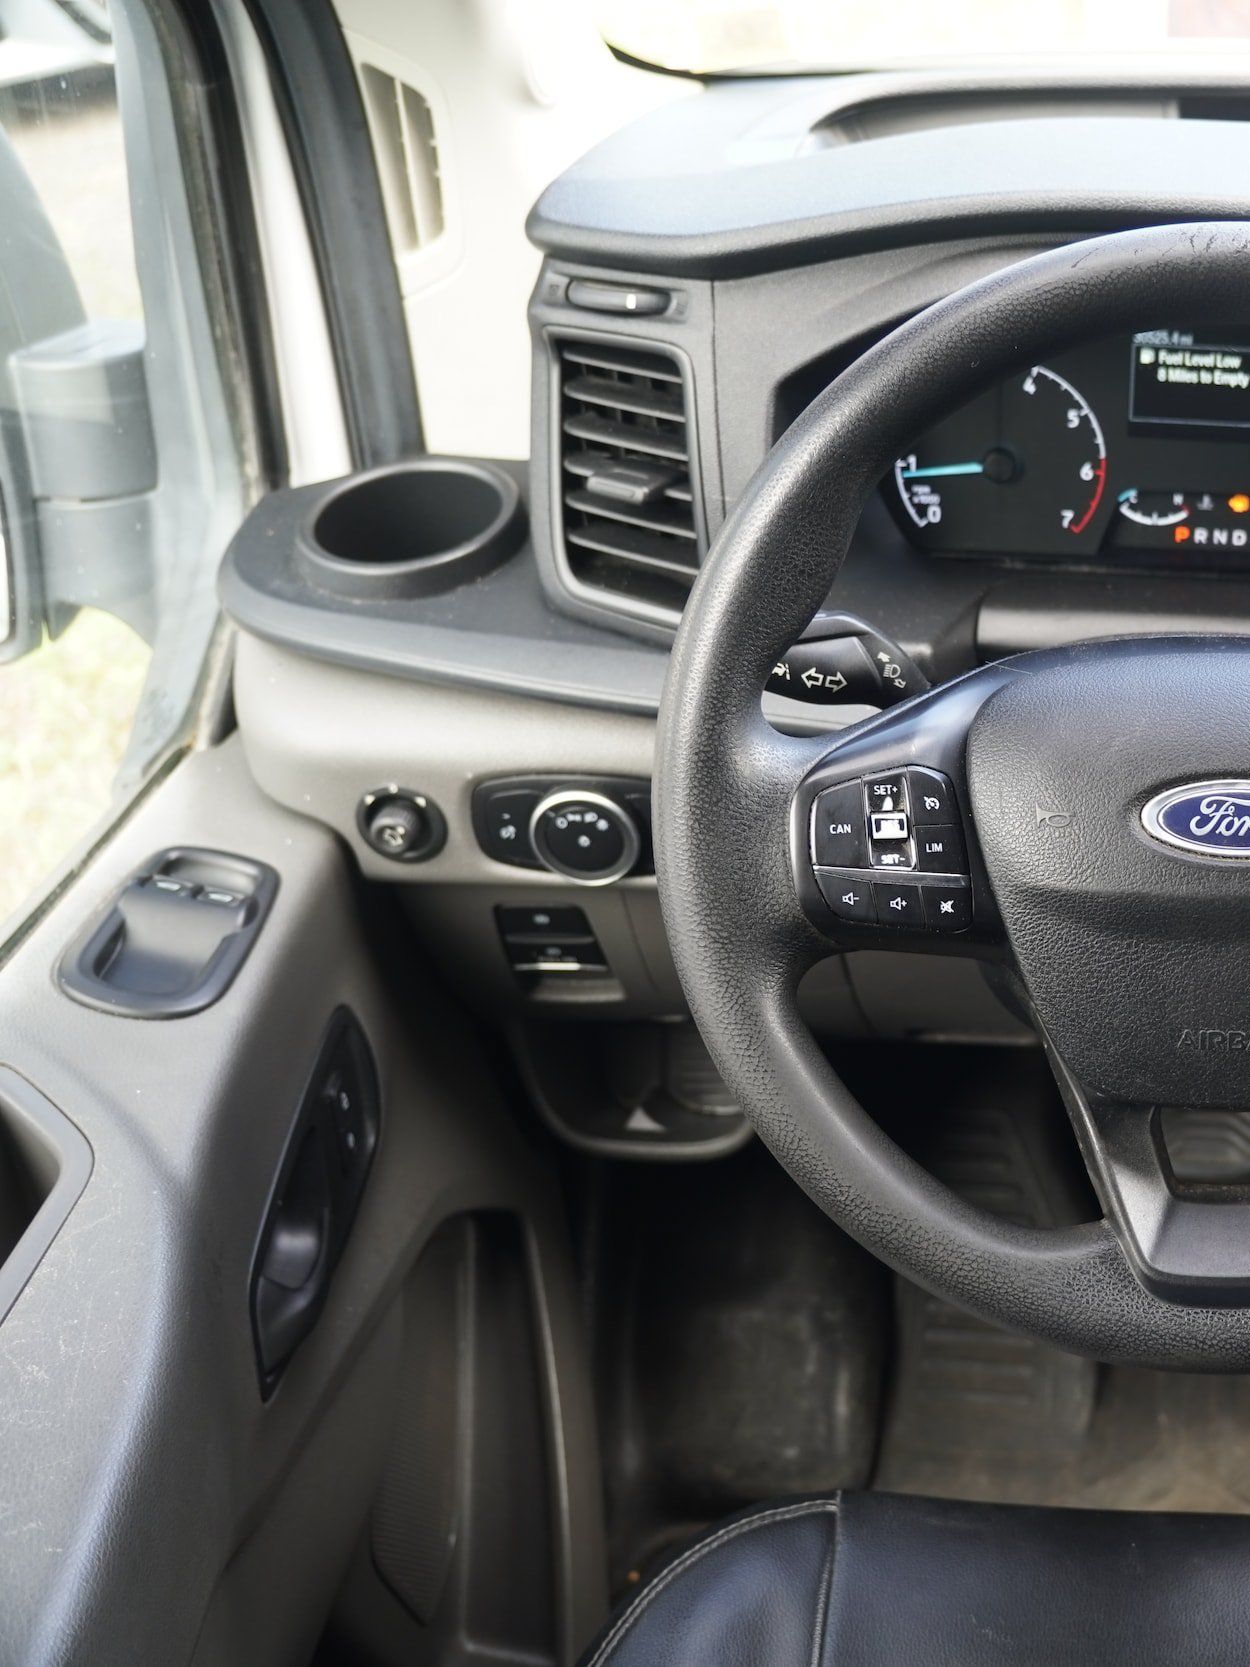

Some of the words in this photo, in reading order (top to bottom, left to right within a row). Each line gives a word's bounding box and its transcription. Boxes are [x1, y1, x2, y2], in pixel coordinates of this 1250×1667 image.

[1158, 349, 1183, 366] Fuel
[1184, 351, 1216, 368] Level
[1216, 353, 1242, 370] Low
[1022, 376, 1036, 395] 4
[1167, 366, 1199, 384] Miles
[1200, 369, 1213, 384] to
[1213, 369, 1250, 389] Empty
[1066, 408, 1080, 429] 5
[906, 454, 917, 472] 1
[1080, 462, 1094, 481] 6
[927, 505, 942, 523] 0
[1061, 510, 1074, 528] 7
[1175, 526, 1190, 543] P
[1194, 527, 1208, 544] R
[1213, 529, 1227, 545] N
[1232, 530, 1247, 546] D
[874, 784, 898, 796] SET+
[829, 823, 851, 835] CAN
[925, 842, 943, 853] LIM
